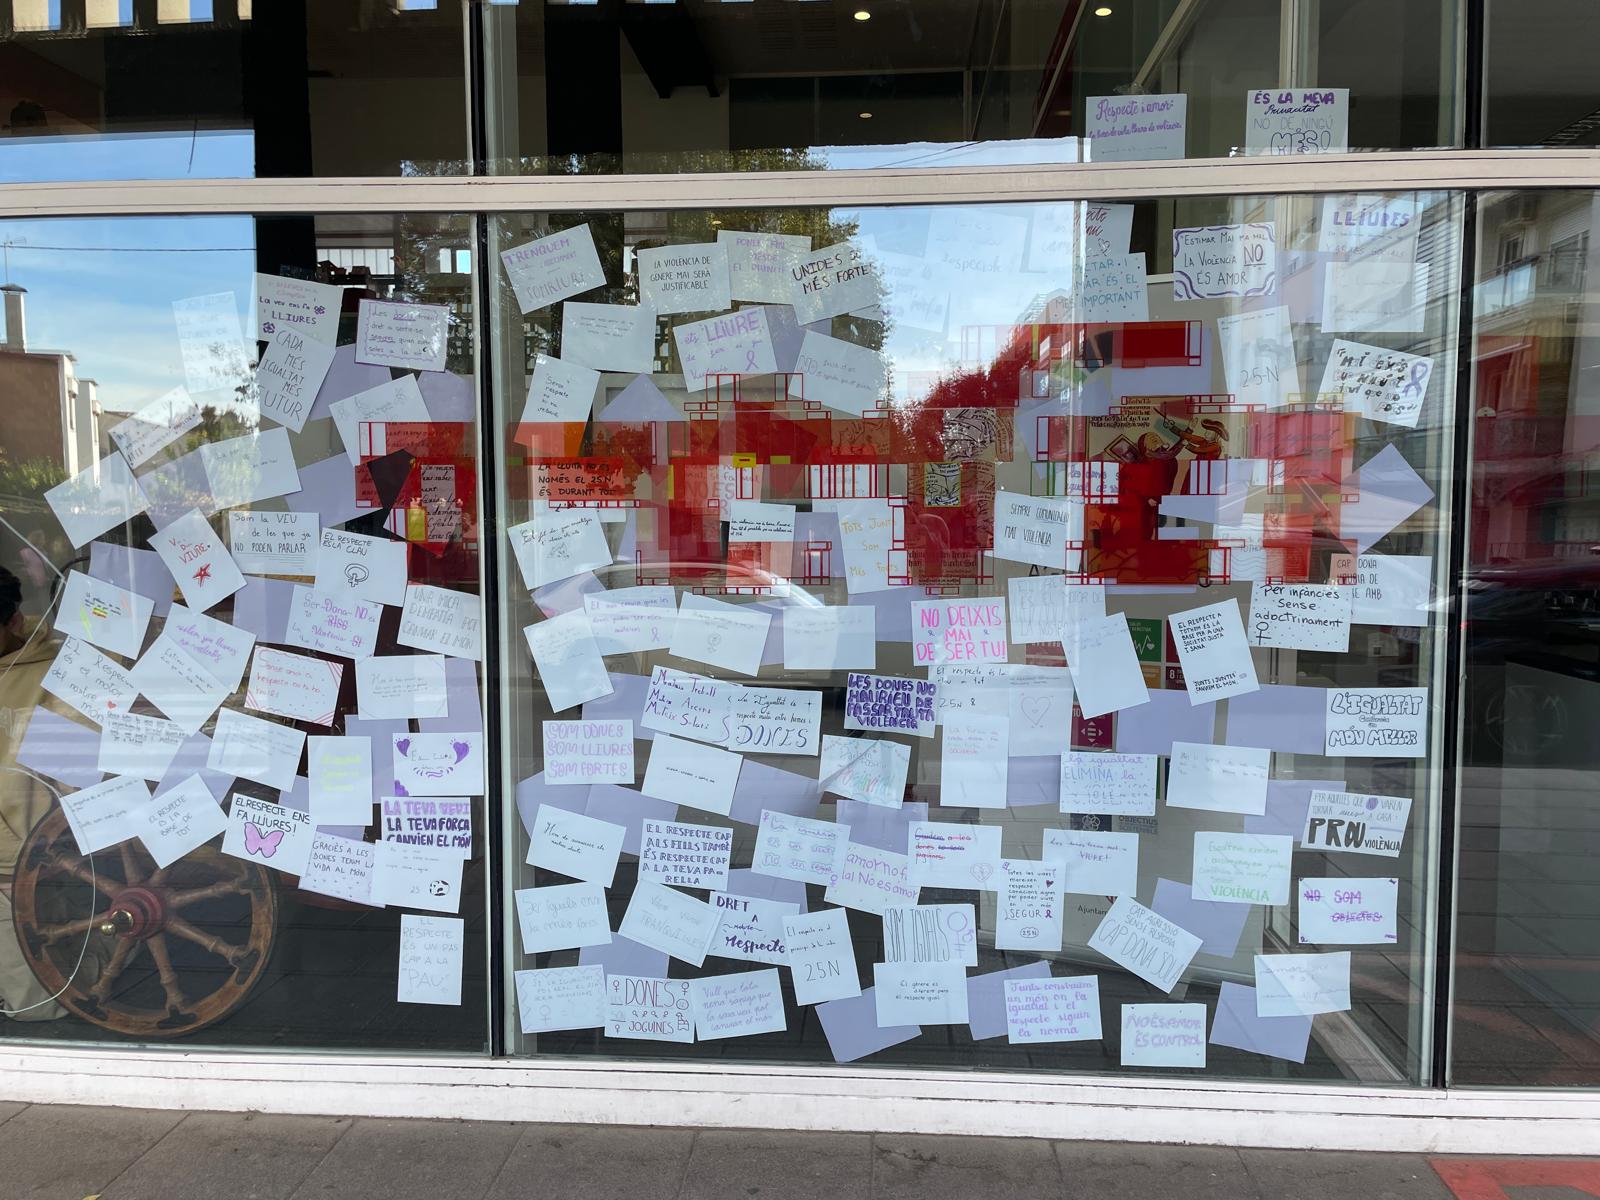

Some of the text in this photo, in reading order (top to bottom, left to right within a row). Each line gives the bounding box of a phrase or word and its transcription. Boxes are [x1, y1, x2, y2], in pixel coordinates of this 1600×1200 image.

[1255, 92, 1335, 104] ÉS LA MEVA
[1254, 117, 1270, 129] NO
[1281, 117, 1293, 129] DE
[702, 255, 712, 265] DE
[1184, 255, 1195, 268] LA
[1243, 243, 1264, 264] NO
[792, 252, 842, 281] UNIDES
[677, 271, 690, 279] MAI
[1217, 272, 1248, 286] AMOR
[661, 280, 709, 292] JUSTIFICABLE
[803, 277, 830, 295] MÉS
[271, 310, 317, 325] LLIURES
[276, 329, 303, 351] CADA
[263, 359, 305, 385] IGUALTAT
[257, 385, 303, 421] FUTUR
[538, 473, 585, 484] NOMÉS EL
[558, 487, 595, 496] DURANT
[277, 513, 297, 524] VEU
[252, 528, 261, 537] de
[282, 532, 295, 541] que
[1004, 525, 1018, 538] MAI
[324, 532, 372, 547] EL RESPECTE
[234, 542, 306, 553] NO PODEN PARLAR
[1358, 559, 1377, 568] DONA
[1263, 585, 1340, 600] Per infàncies
[1277, 599, 1317, 611] Sense
[921, 605, 1002, 628] NO DEIXIS
[1188, 613, 1216, 626] RESPECTE
[1255, 610, 1343, 628] adoctrinament
[944, 628, 973, 642] MAI
[1182, 633, 1195, 641] BASE
[1212, 626, 1225, 634] UNA
[916, 642, 935, 661] DE
[945, 642, 977, 660] SER
[1169, 669, 1175, 679] 8
[70, 683, 96, 700] nostre
[96, 678, 123, 697] motor
[849, 674, 936, 695] LES DONES NO
[916, 697, 932, 708] DE
[1331, 692, 1423, 715] L'IGUALTAT
[584, 723, 623, 738] DONES
[736, 726, 808, 748] DONES
[1367, 729, 1417, 745] MELLOR
[1064, 766, 1113, 782] ELIMINA
[235, 797, 310, 824] EL RESPECTE ENS
[237, 809, 249, 820] FA
[384, 800, 437, 816] LA TEVA
[386, 818, 470, 831] LA TEVA FORÇA
[646, 823, 731, 841] EL RESPECTE CAP
[437, 833, 471, 848] EL MÓN
[1308, 818, 1366, 849] PROU
[646, 838, 668, 848] ALS
[313, 853, 336, 862] DONES
[356, 849, 368, 857] LES
[644, 848, 728, 865] ÉS RESPECTE CAP
[335, 866, 345, 874] AL
[654, 863, 669, 873] LA
[672, 864, 702, 875] TEVA
[716, 896, 750, 912] DRET
[1334, 889, 1362, 905] SOM
[752, 914, 759, 923] A
[1009, 909, 1042, 918] SEGUR
[1130, 904, 1146, 919] CAP
[1099, 919, 1184, 984] CAP DONA SOLA
[806, 960, 841, 983] 25N
[625, 978, 675, 1007] DONES
[628, 1020, 674, 1034] JOGUINES
[1039, 1026, 1079, 1036] norma
